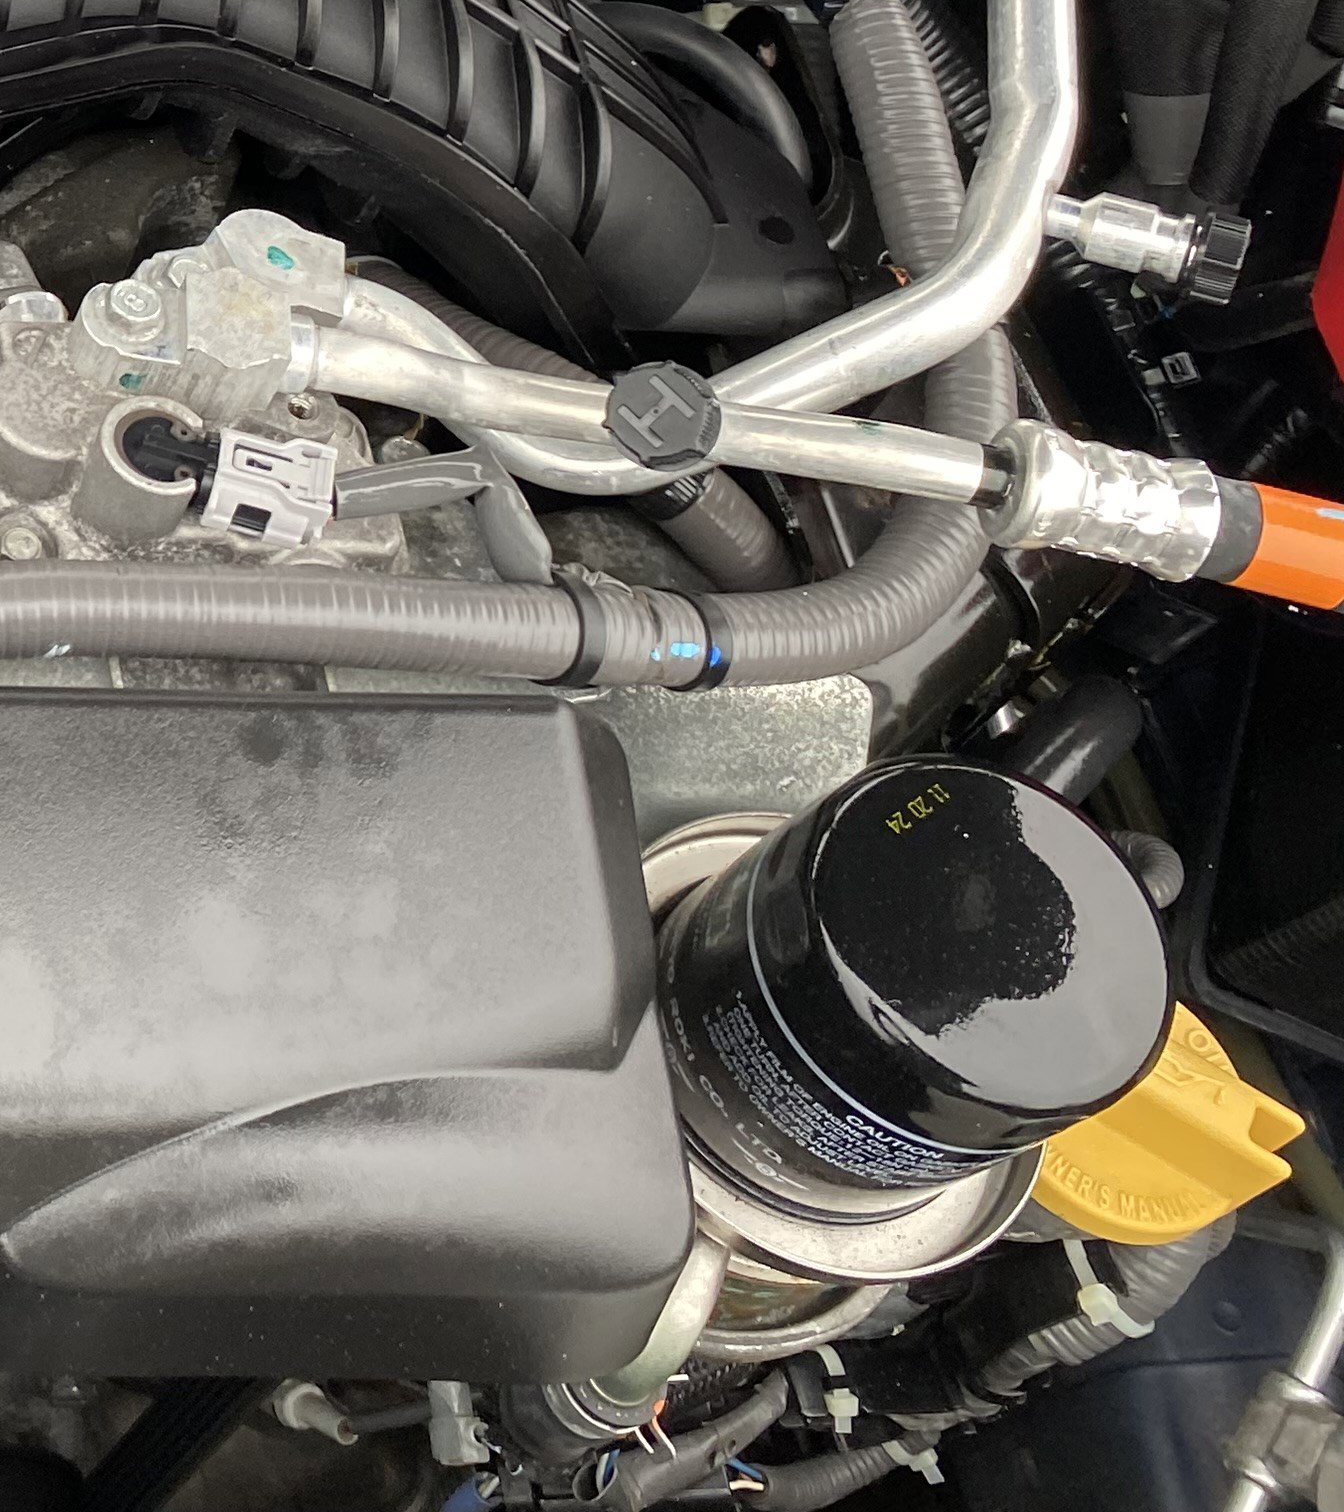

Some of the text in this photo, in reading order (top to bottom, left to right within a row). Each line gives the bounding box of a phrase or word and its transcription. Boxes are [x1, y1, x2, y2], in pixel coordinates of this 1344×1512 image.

[885, 783, 951, 835] 11 20 24
[670, 996, 695, 1063] ROKI
[747, 1091, 808, 1148] OWNER'S
[806, 1144, 869, 1179] MANUAL
[772, 1107, 790, 1124] TO
[789, 1122, 844, 1161] ADJUST
[780, 1080, 822, 1121] AFTER
[822, 1119, 894, 1160] CONTACT
[792, 1082, 814, 1103] OF
[811, 1100, 866, 1140] ENGINE
[864, 1137, 892, 1152] OIL
[891, 1150, 919, 1161] ON
[817, 1134, 865, 1162] AFTER
[846, 1115, 944, 1159] CAUTION
